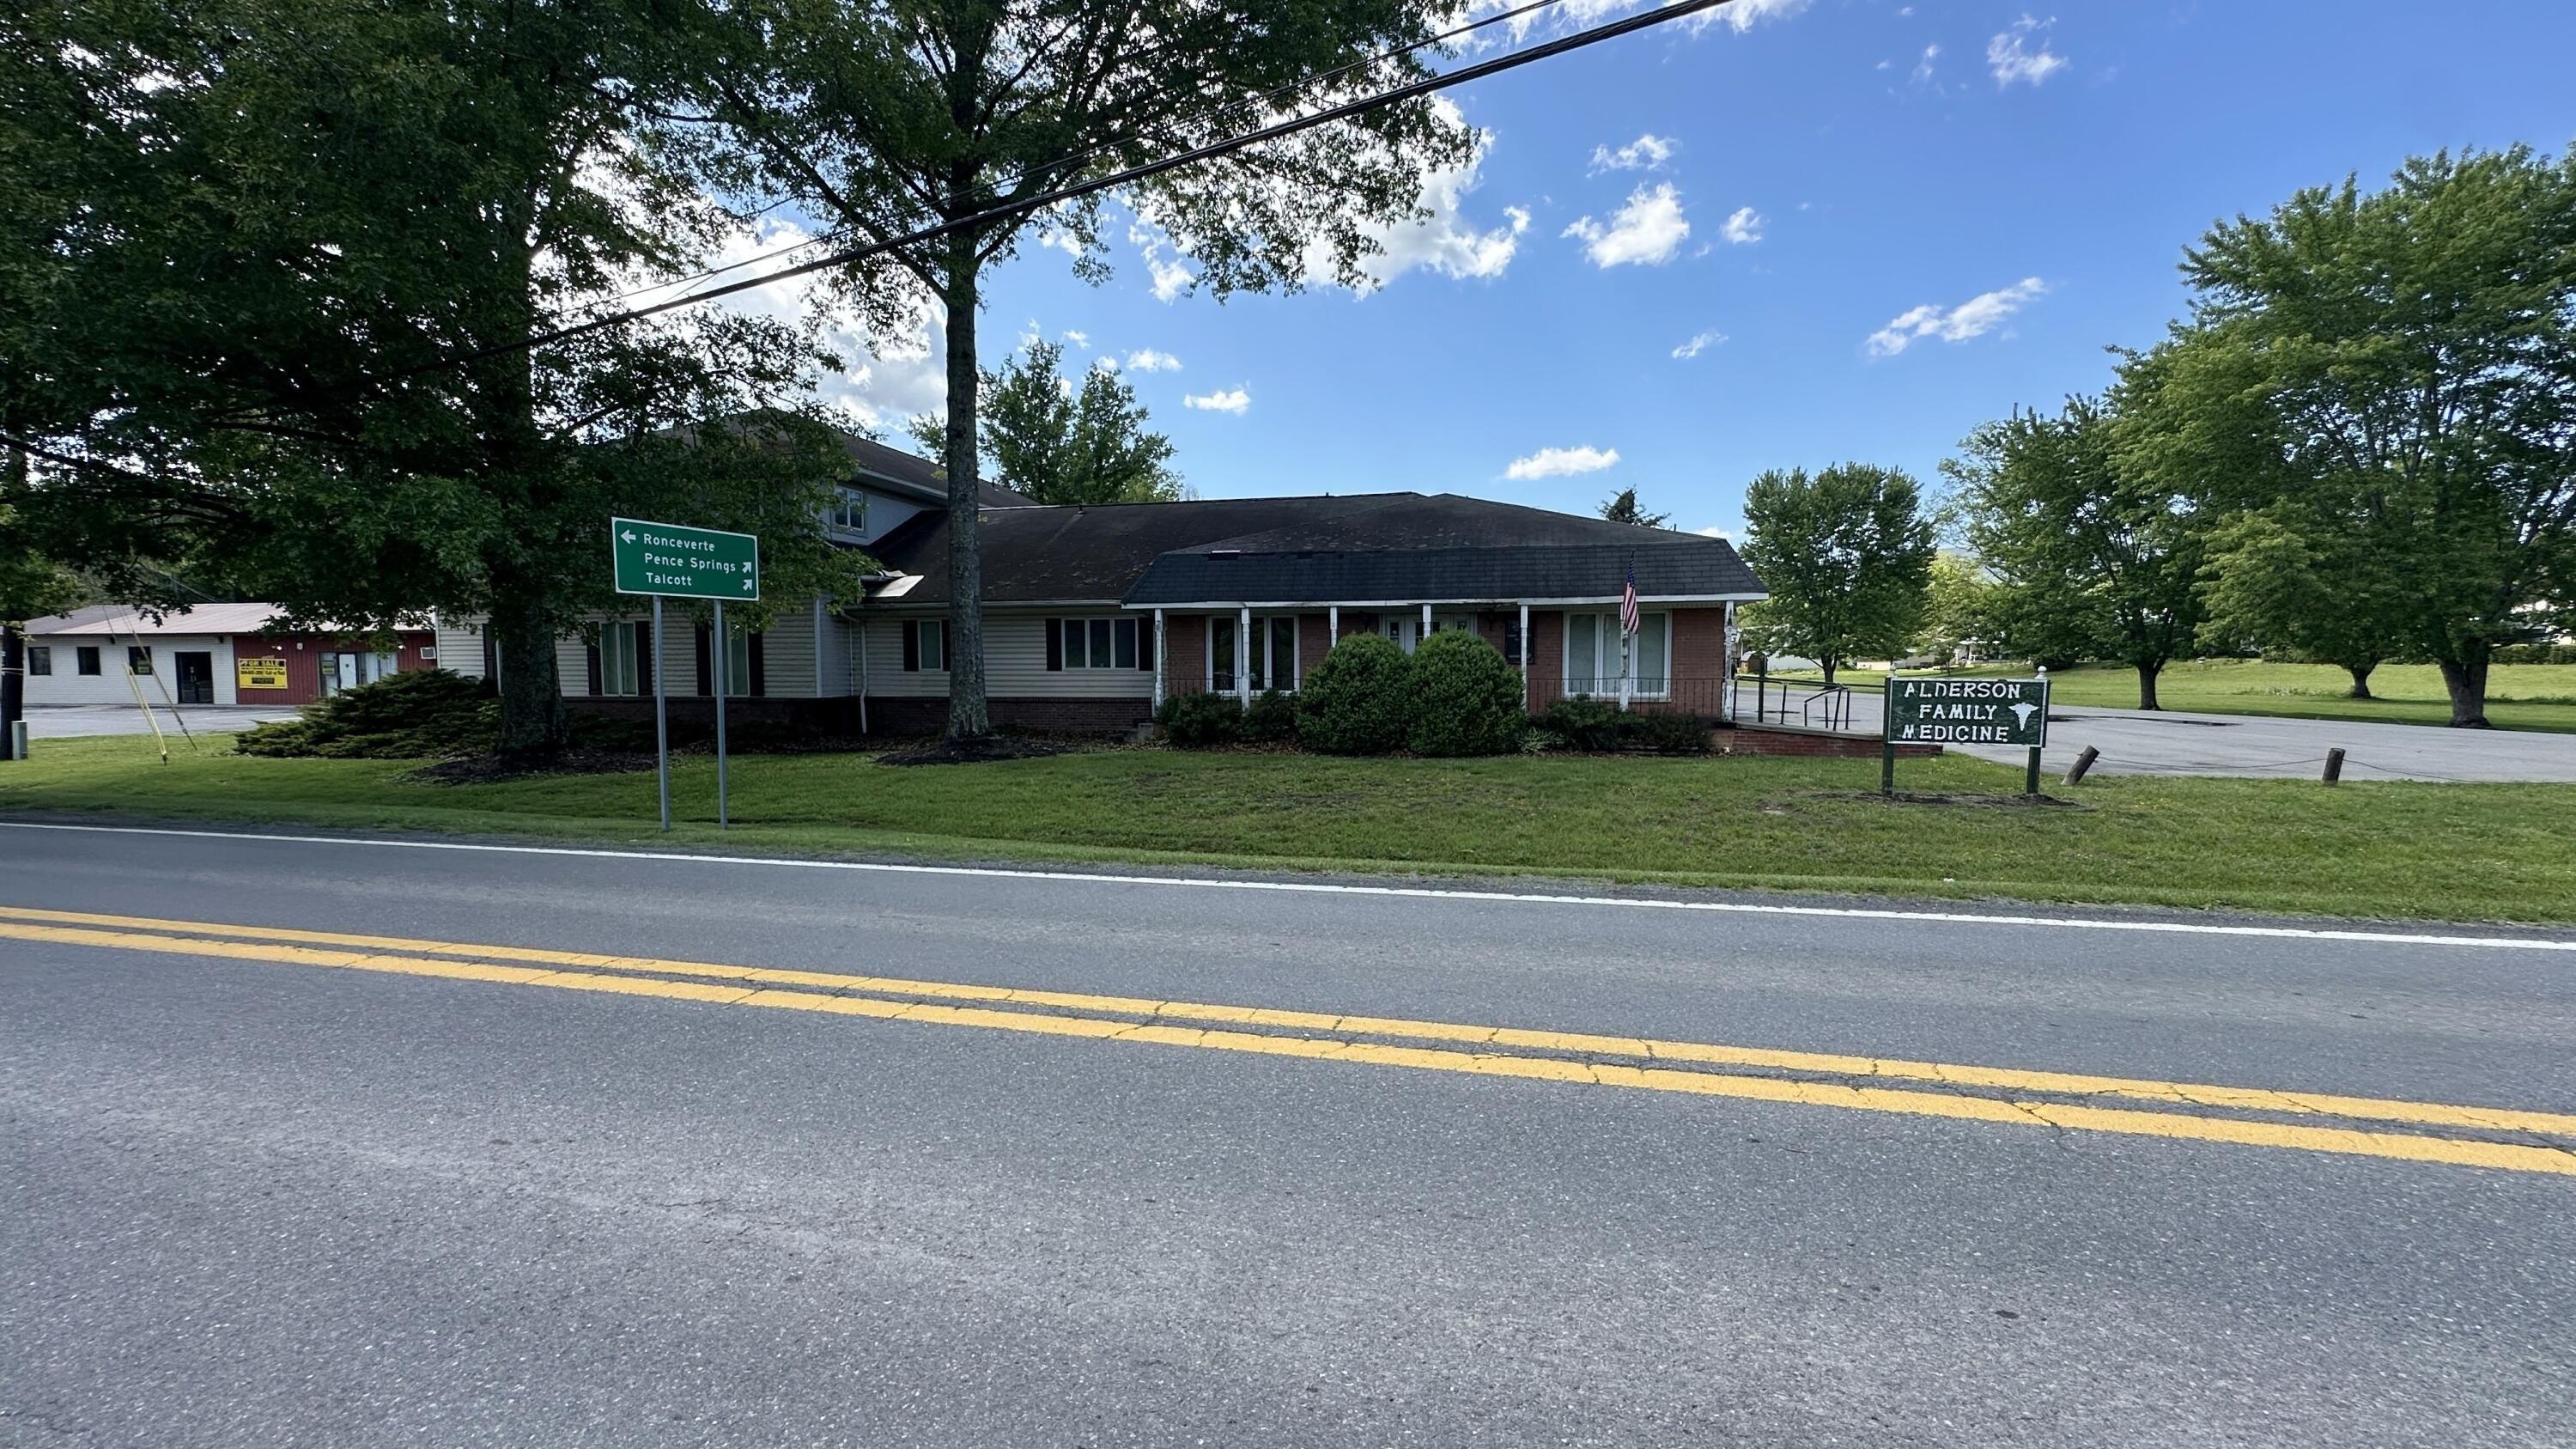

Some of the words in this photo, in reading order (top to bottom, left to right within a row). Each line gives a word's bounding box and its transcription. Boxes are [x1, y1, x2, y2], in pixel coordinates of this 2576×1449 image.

[643, 533, 715, 551] Ronceverte
[645, 552, 683, 567] Pence
[690, 557, 736, 574] Springs
[646, 572, 692, 586] Talcott
[1904, 682, 2020, 698] ALDERSON
[1919, 703, 1997, 720] FAMILY
[1902, 724, 2009, 742] MEDICINE
